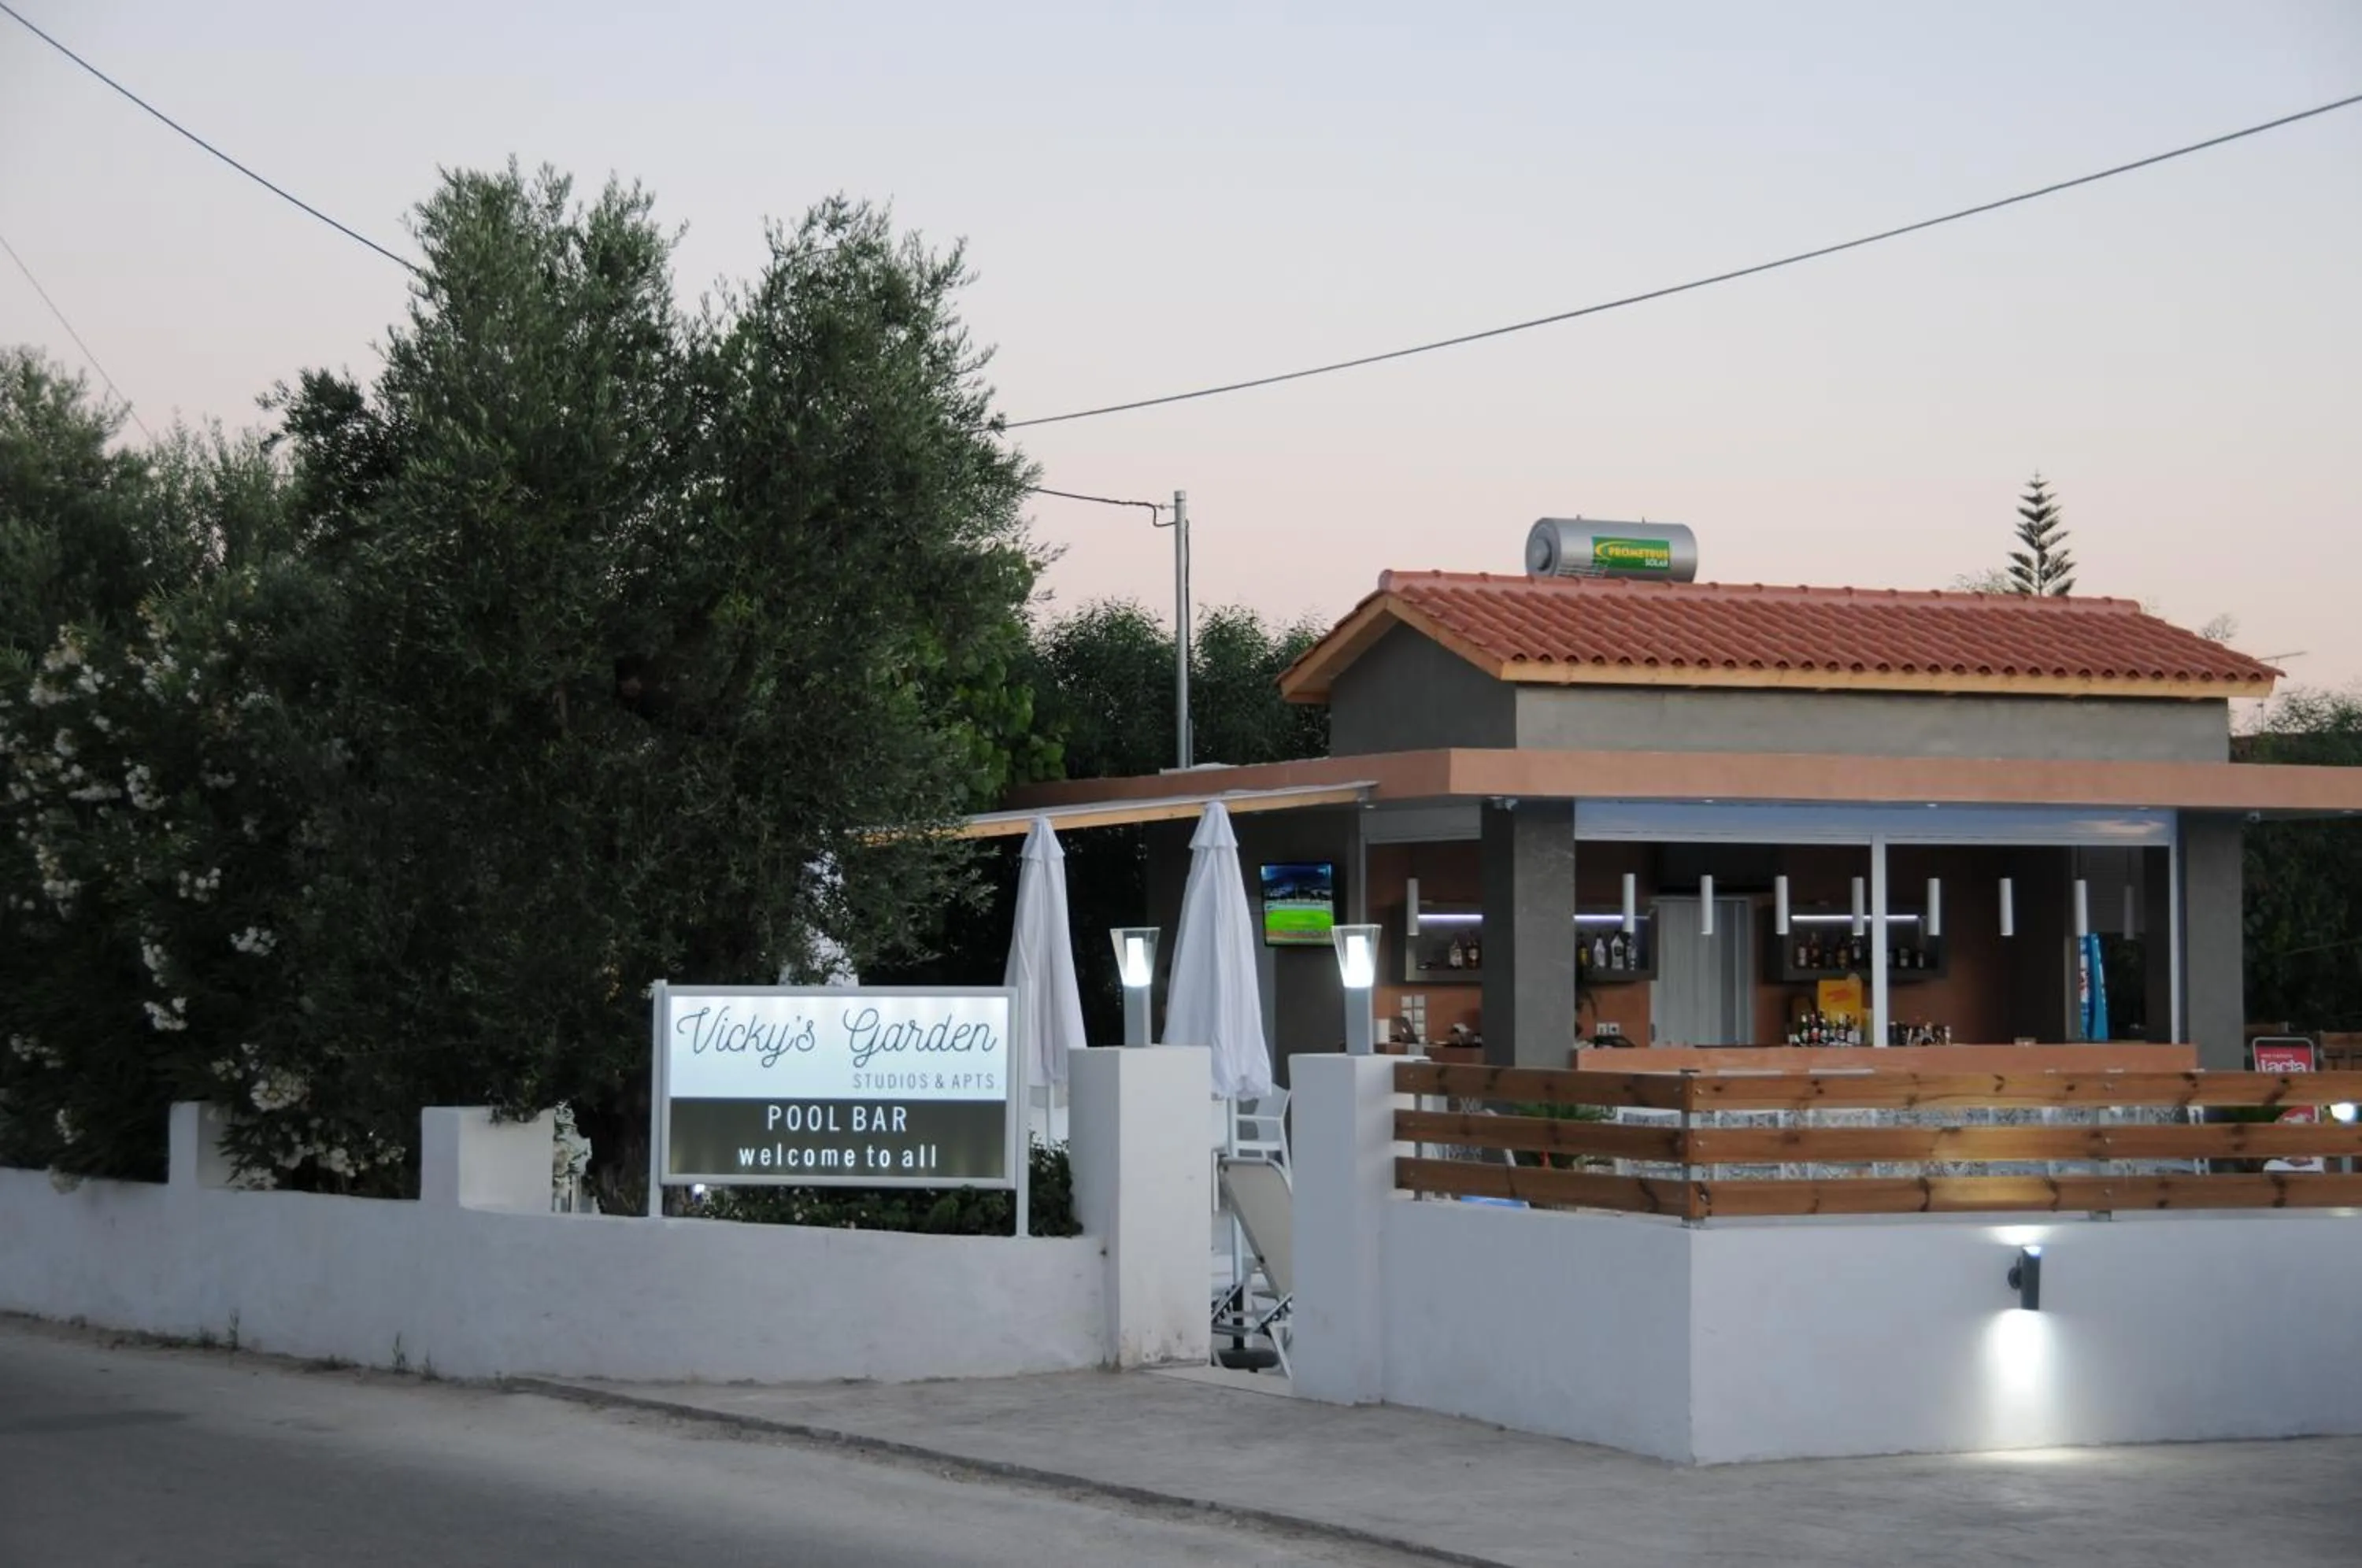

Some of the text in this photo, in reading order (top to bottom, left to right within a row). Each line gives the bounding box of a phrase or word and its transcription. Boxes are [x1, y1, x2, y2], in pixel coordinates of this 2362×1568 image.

[676, 1006, 998, 1068] Vicky's Garden
[853, 1073, 928, 1089] STUDIOS
[935, 1073, 945, 1089] &
[767, 1105, 908, 1132] POOL BAR
[739, 1142, 937, 1168] welcome to all
